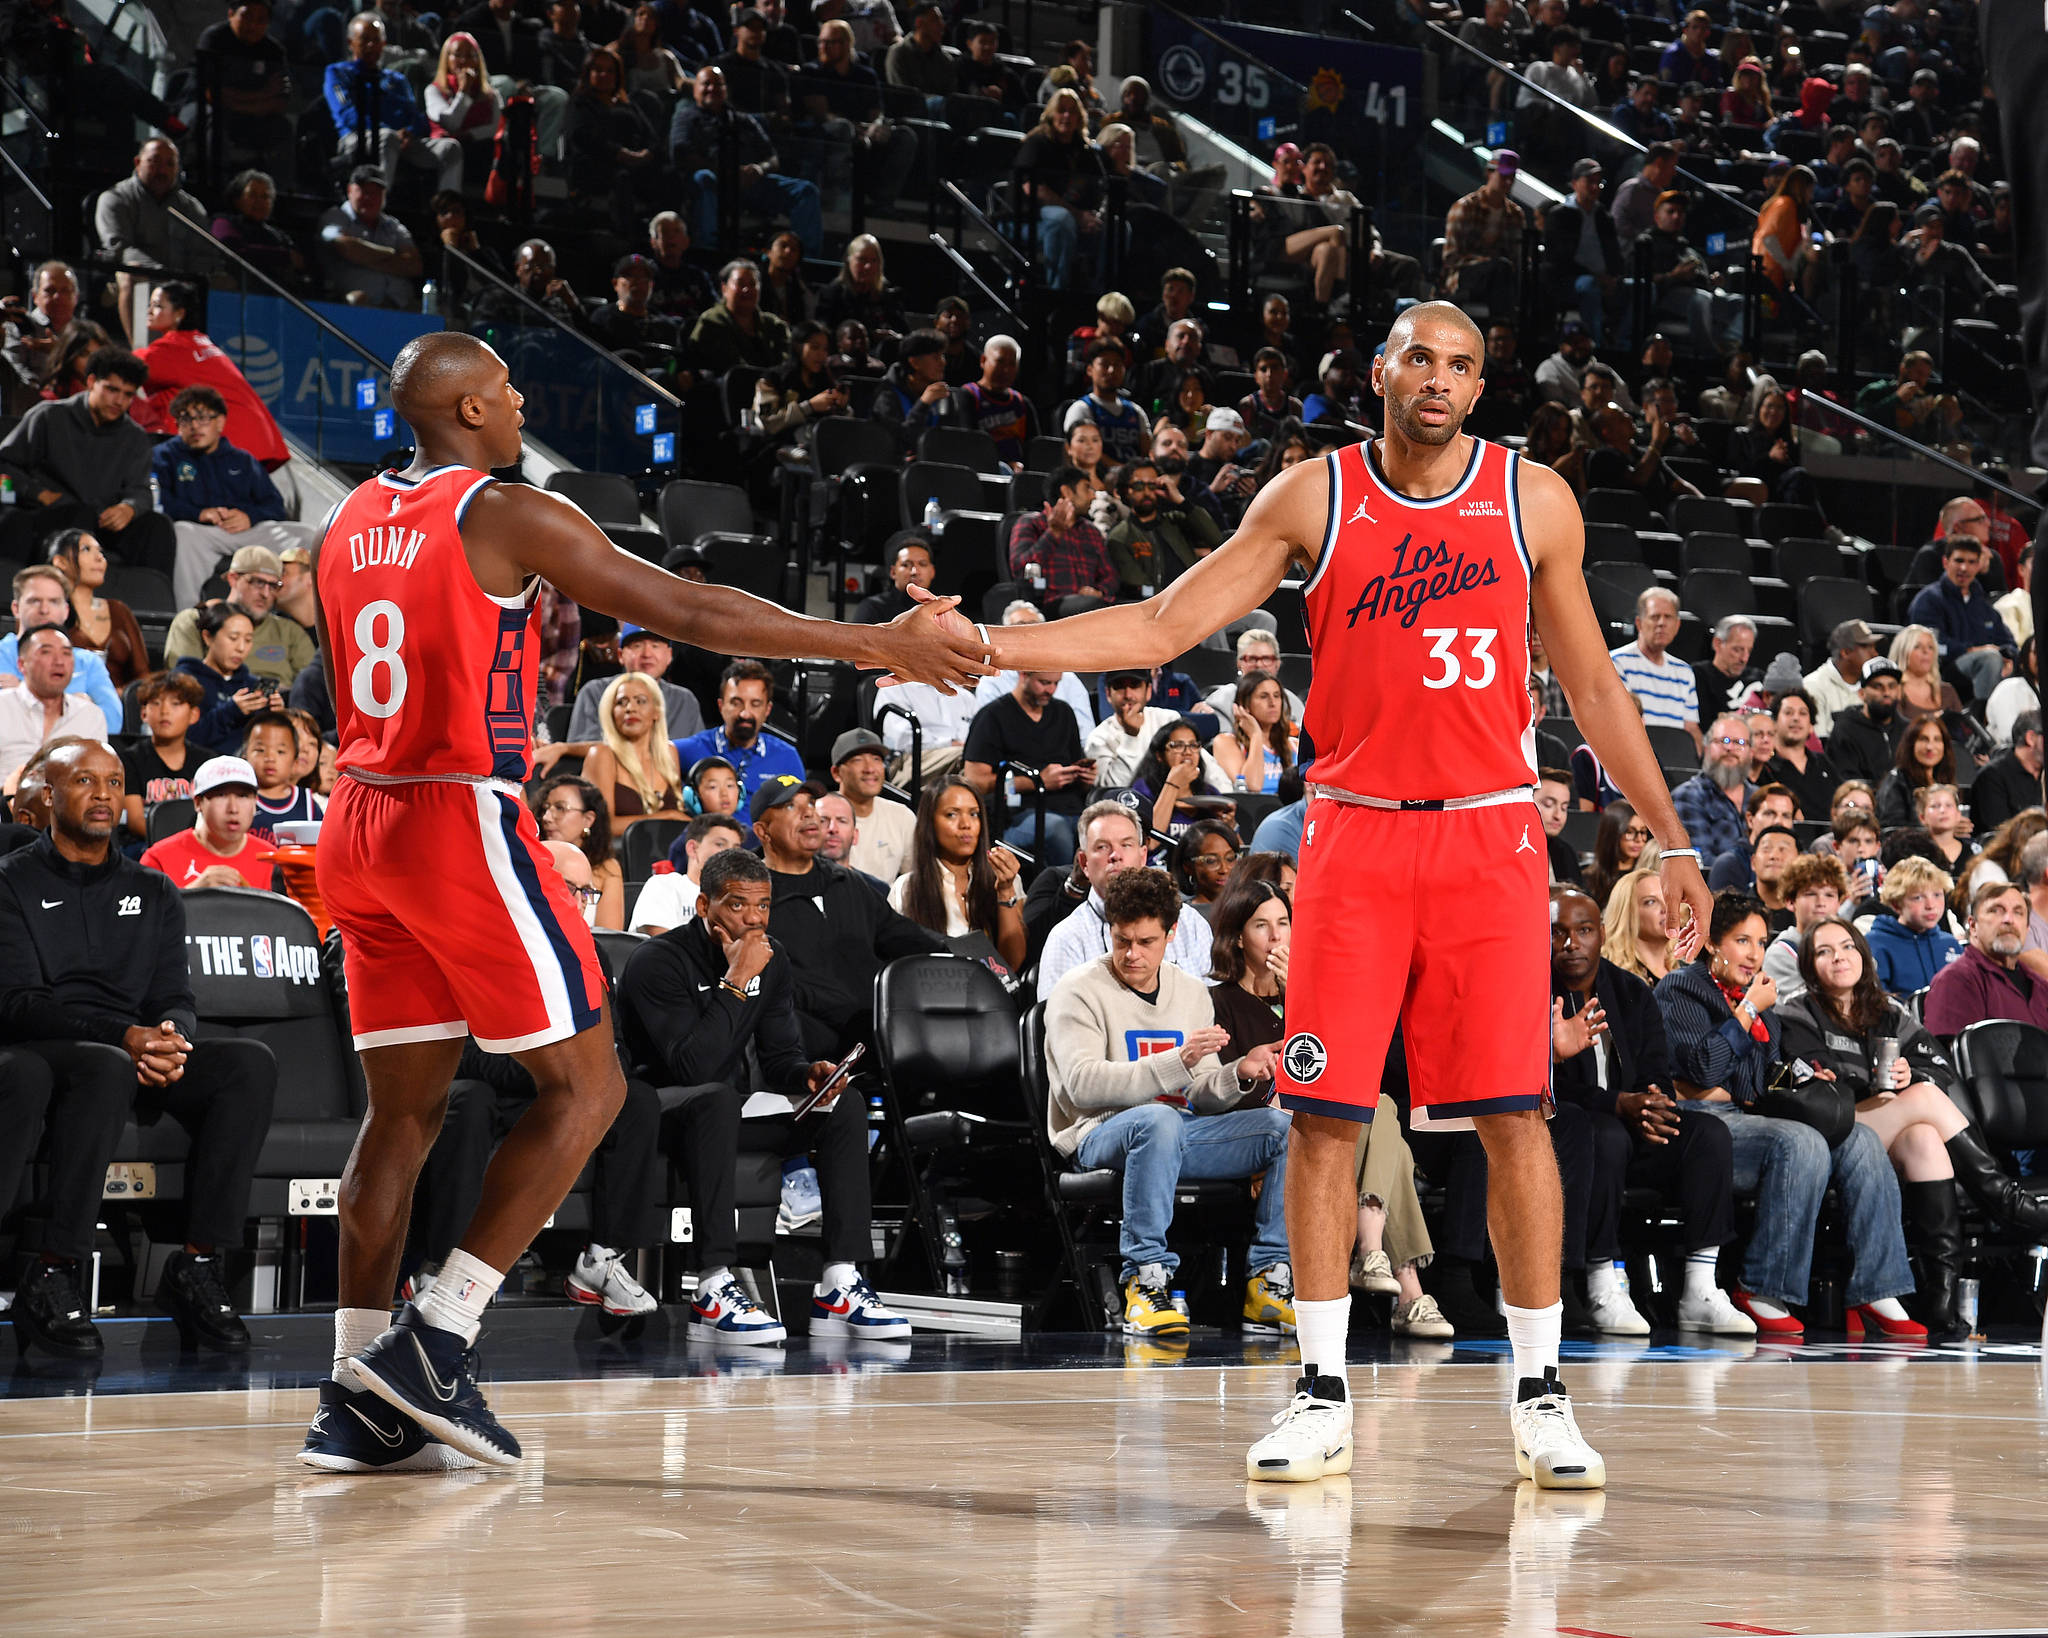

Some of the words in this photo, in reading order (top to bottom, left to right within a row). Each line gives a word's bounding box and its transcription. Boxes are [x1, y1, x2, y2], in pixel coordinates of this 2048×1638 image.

[1217, 61, 1270, 108] 35
[1364, 81, 1406, 127] 41
[1459, 508, 1503, 517] RWANDA
[1468, 501, 1493, 509] VISIT
[349, 526, 426, 573] DUNN
[1388, 533, 1453, 580] Los
[1346, 552, 1500, 629] Angeles
[351, 600, 407, 718] 8
[1422, 627, 1498, 690] 33
[196, 936, 248, 975] THE
[275, 936, 321, 985] App
